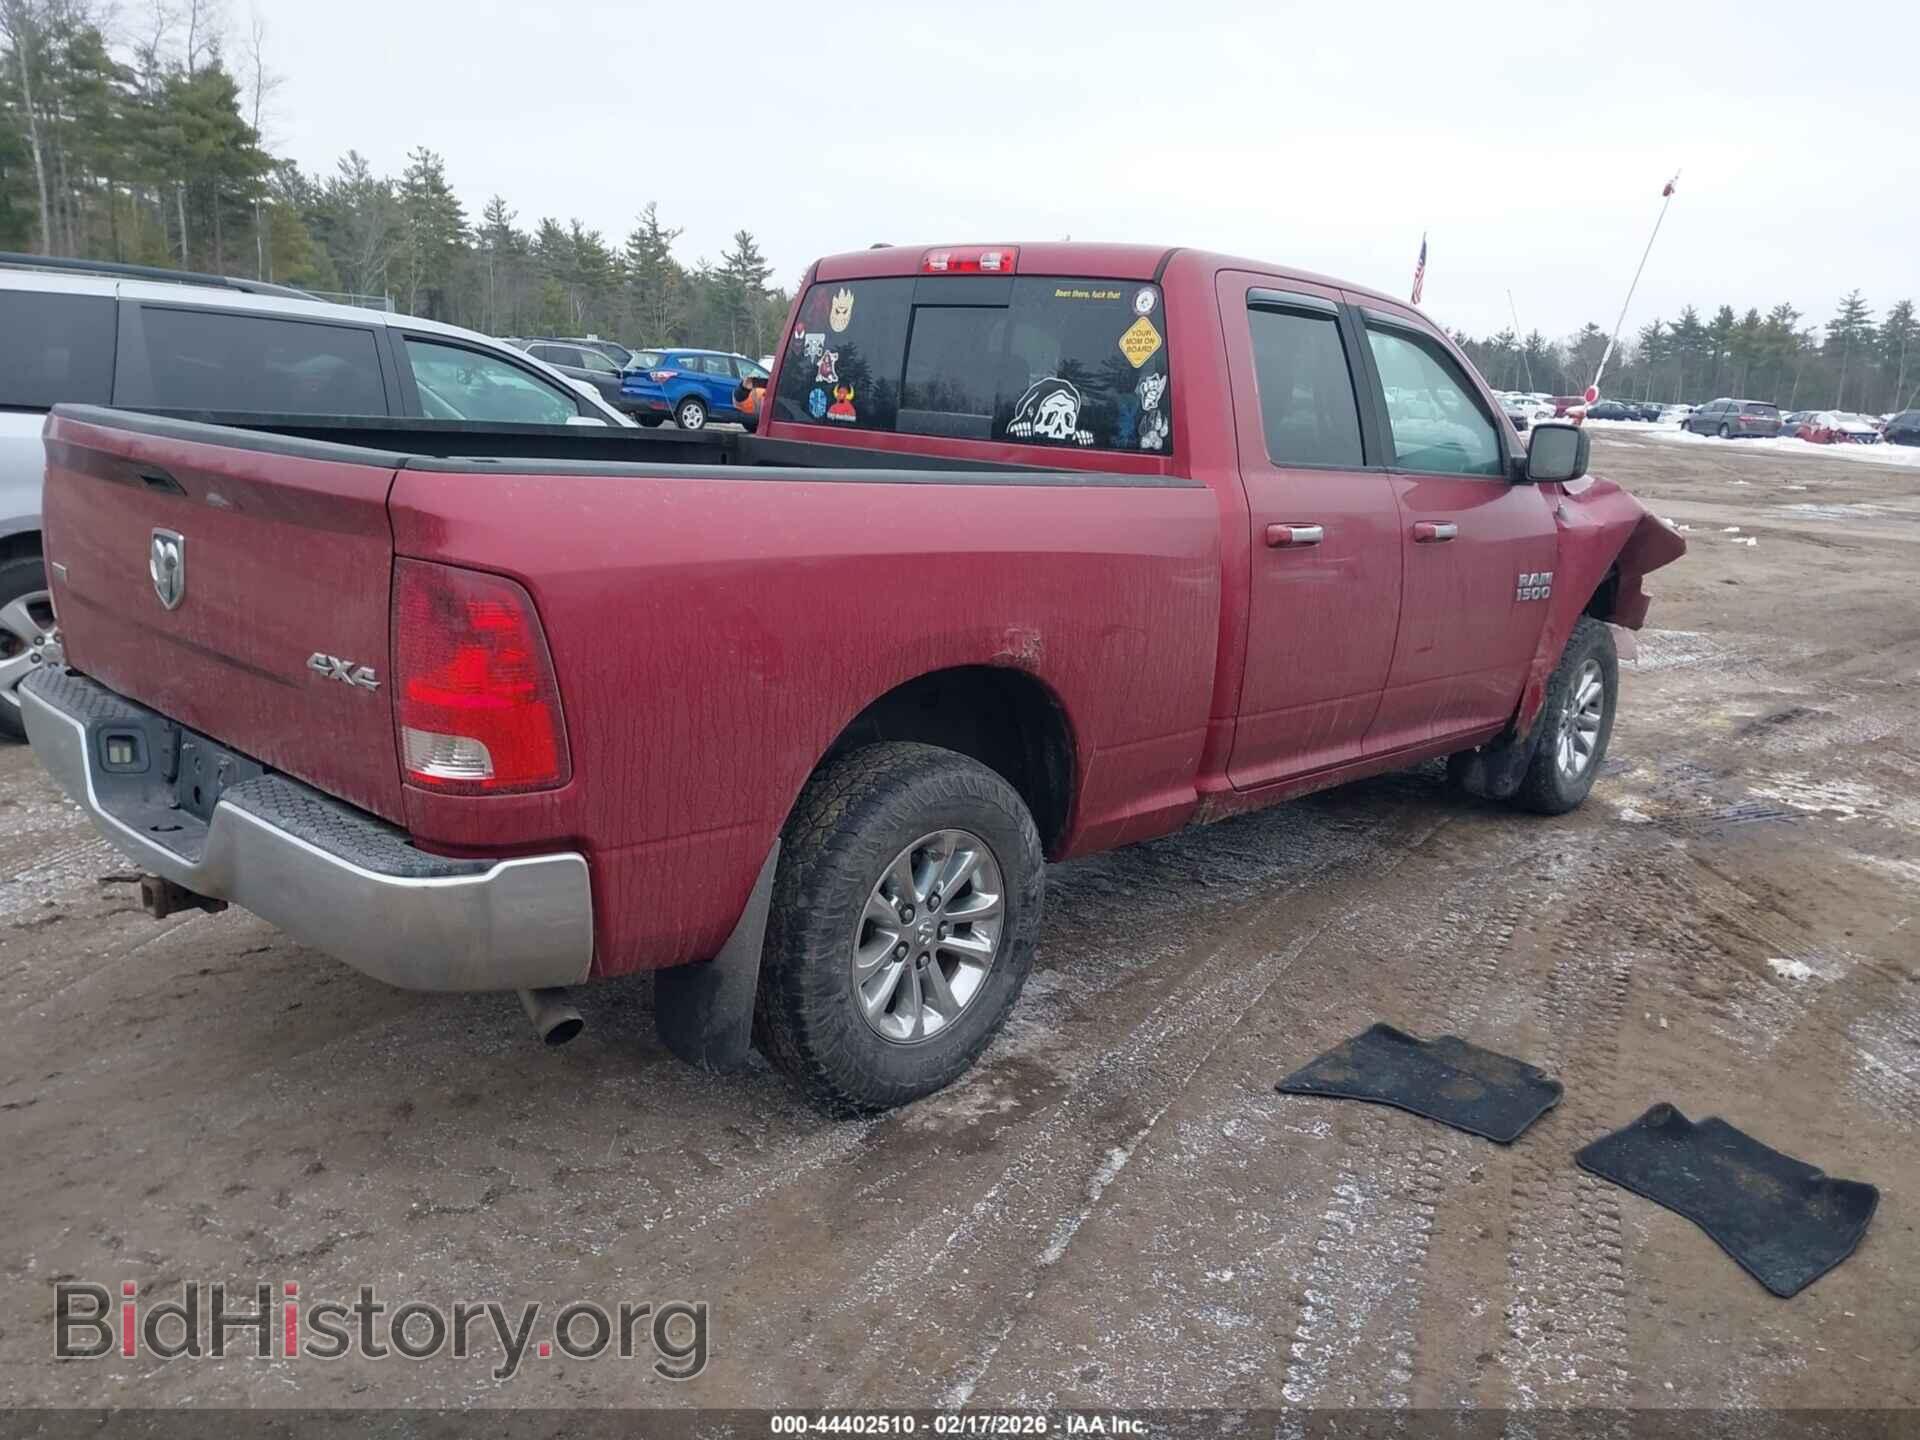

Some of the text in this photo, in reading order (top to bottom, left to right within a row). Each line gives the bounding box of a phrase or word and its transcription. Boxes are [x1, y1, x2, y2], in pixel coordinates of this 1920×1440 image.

[1126, 337, 1142, 345] MOM
[1519, 572, 1553, 586] RAM
[1516, 587, 1551, 601] 1500
